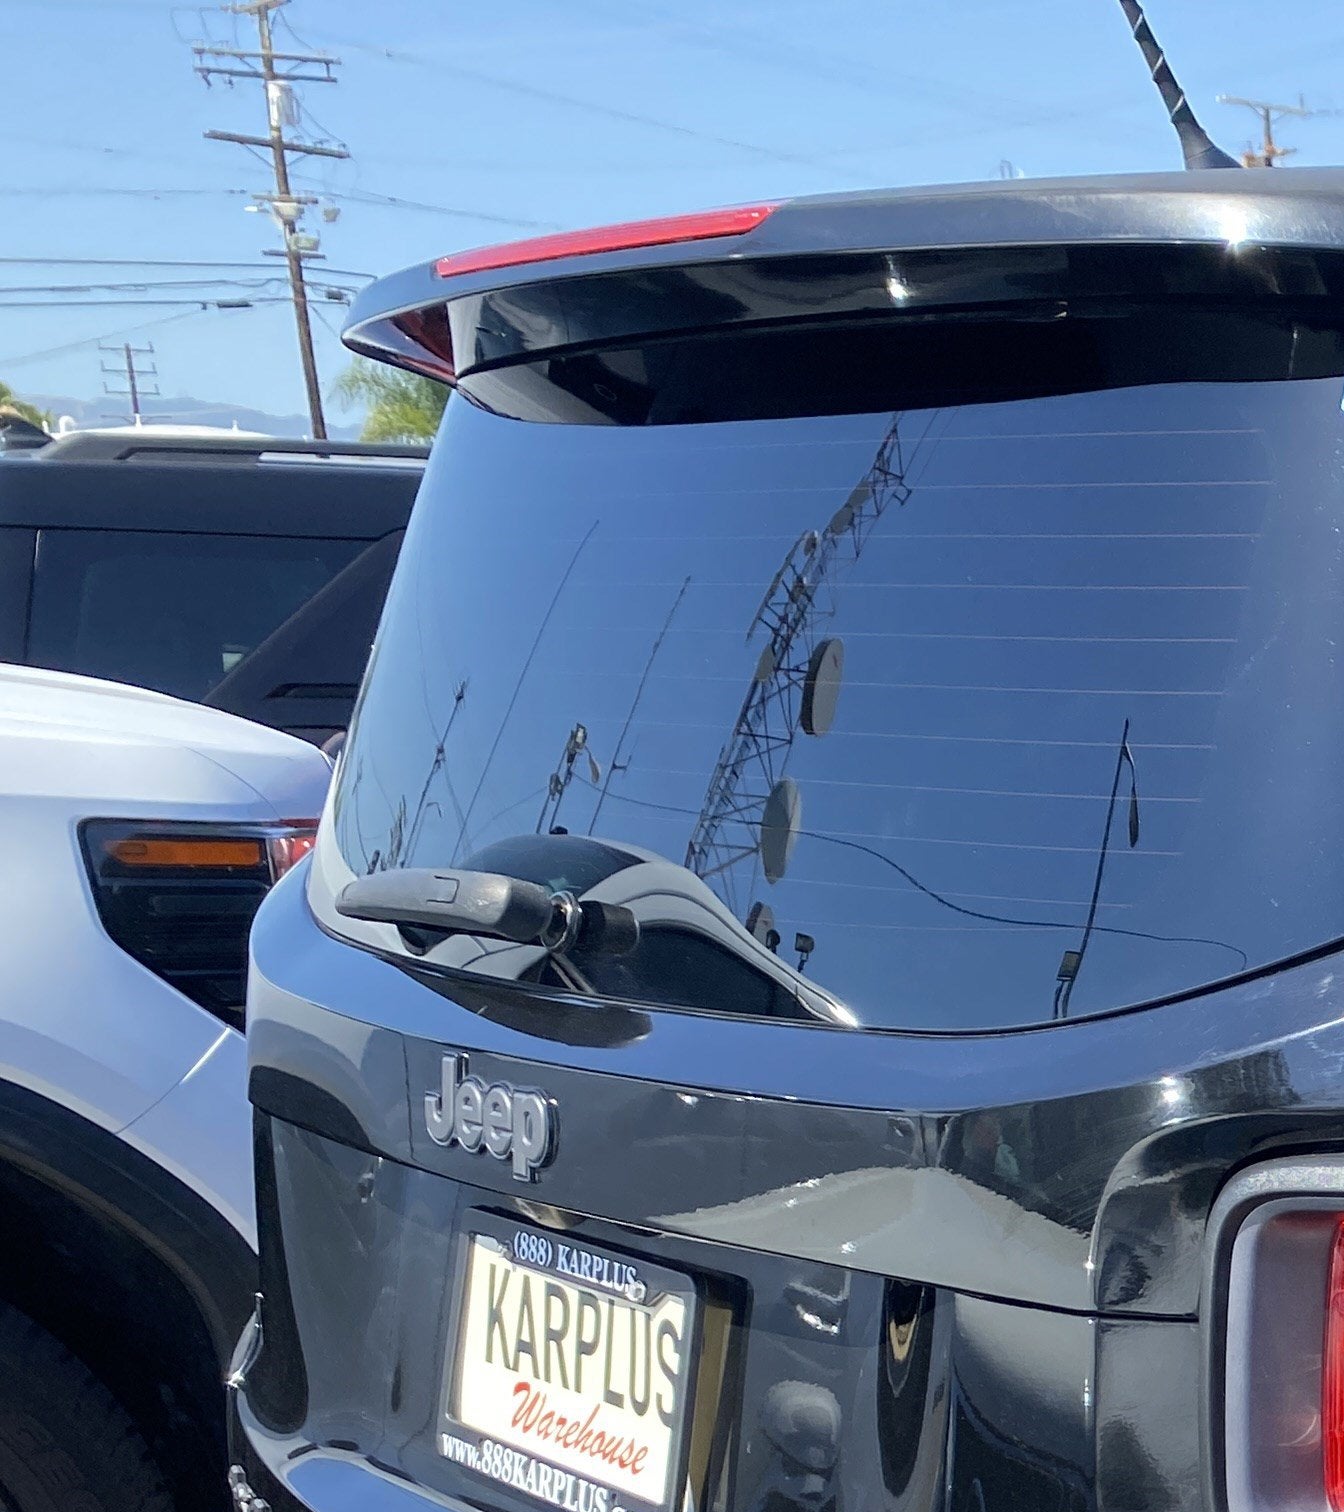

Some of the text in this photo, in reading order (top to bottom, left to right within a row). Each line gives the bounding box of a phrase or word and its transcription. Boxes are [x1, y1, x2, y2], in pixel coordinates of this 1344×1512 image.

[424, 1050, 559, 1184] Jeep
[513, 1230, 638, 1294] (888) KARPLUS
[485, 1262, 684, 1429] KARPLUS
[512, 1381, 650, 1477] Warehouse
